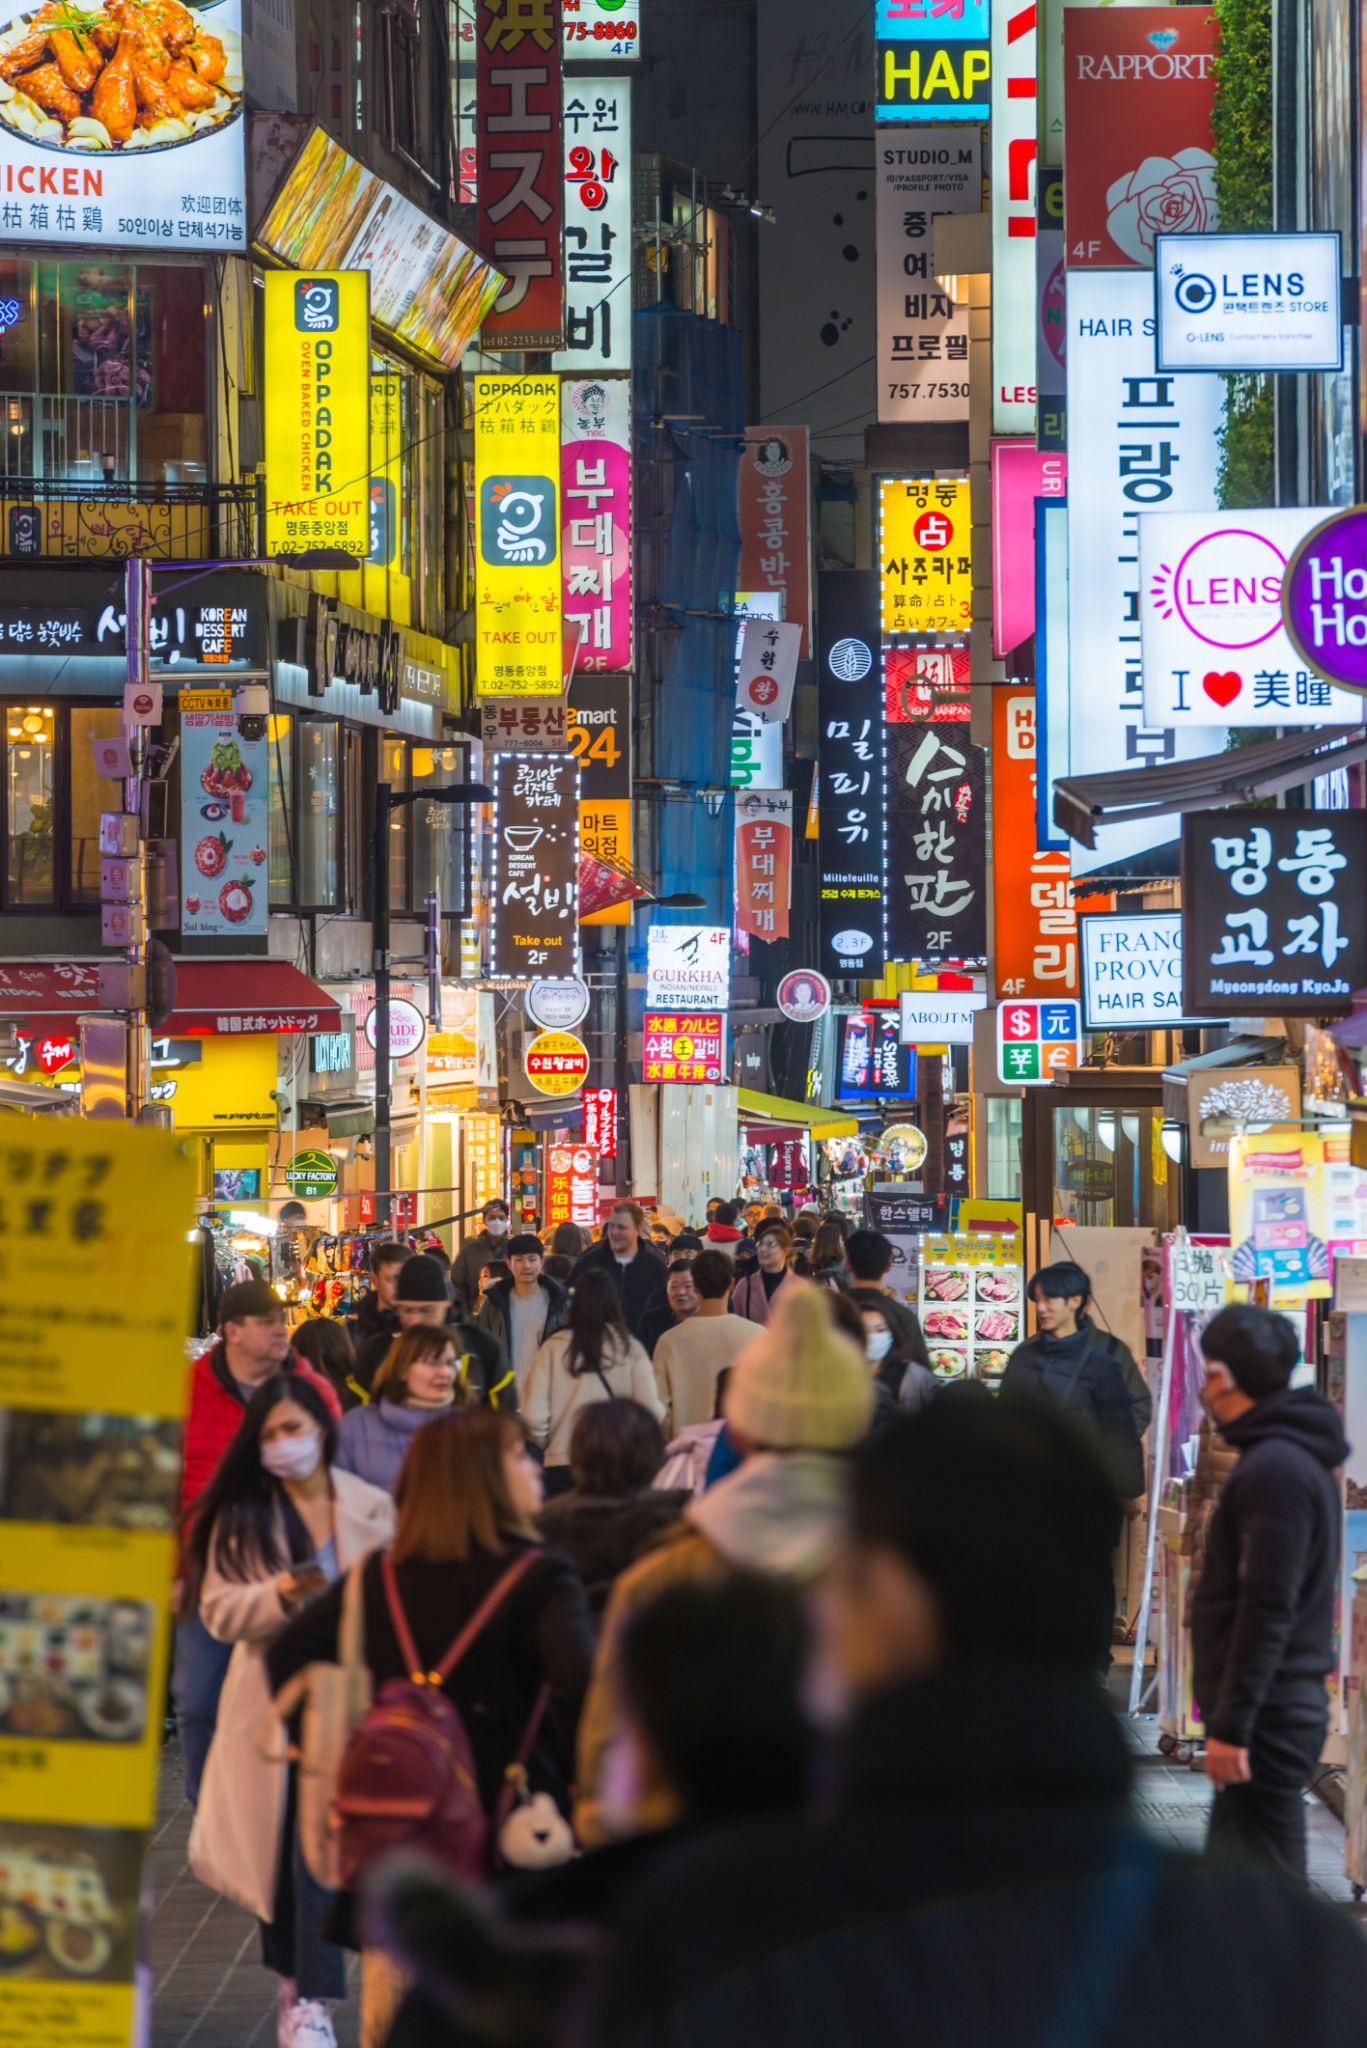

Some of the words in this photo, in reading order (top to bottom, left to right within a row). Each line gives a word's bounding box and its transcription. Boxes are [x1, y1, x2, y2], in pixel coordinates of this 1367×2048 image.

[611, 42, 634, 55] 4F
[1077, 54, 1213, 80] RAPPORT
[564, 97, 619, 134] 수원
[934, 183, 964, 191] PHOTO
[181, 195, 243, 216] 欢迎团体
[1072, 240, 1102, 259] 4F
[1290, 301, 1329, 313] STORE
[1079, 318, 1132, 336] HAIR
[891, 334, 967, 361] 프로필
[300, 341, 311, 378] OVEN
[479, 382, 556, 396] OPPADAK
[300, 383, 311, 429] BAKED
[315, 340, 333, 493] OPPADAK
[300, 432, 311, 492] CHICKEN
[906, 484, 957, 508] 명동
[272, 501, 319, 516] TAKE
[324, 501, 363, 516] OUT
[286, 520, 349, 536] 명동중앙점
[919, 516, 947, 546] 占
[1186, 576, 1284, 606] LENS
[201, 608, 247, 622] KOREAN
[195, 623, 247, 637] DESSERT
[483, 631, 521, 645] TAKE
[526, 631, 557, 644] OUT
[202, 639, 232, 652] CAFE
[494, 665, 547, 677] 명동중앙점
[583, 656, 608, 672] 2F
[480, 680, 560, 691] T.02-752-5892
[181, 696, 206, 710] CCTV
[498, 707, 565, 737] 부동산
[567, 726, 622, 769] 24
[583, 814, 619, 832] 마트
[508, 854, 534, 862] KOREAN
[508, 862, 536, 870] DESSERT
[1211, 827, 1348, 896] 명동
[751, 826, 775, 931] 부대찌개
[822, 873, 879, 883] Millefeuille
[512, 934, 541, 946] Take
[544, 936, 562, 946] out
[709, 932, 726, 945] 4F
[926, 931, 953, 950] 2F
[1210, 901, 1350, 969] 교자
[527, 950, 548, 965] 2F
[653, 969, 723, 984] GURKHA
[1001, 978, 1026, 995] 4F
[1210, 980, 1299, 994] Myeongdong
[655, 994, 720, 1005] RESTAURANT
[1099, 992, 1144, 1009] HAIR
[307, 1170, 337, 1181] FACTORY
[305, 1186, 317, 1196] B1
